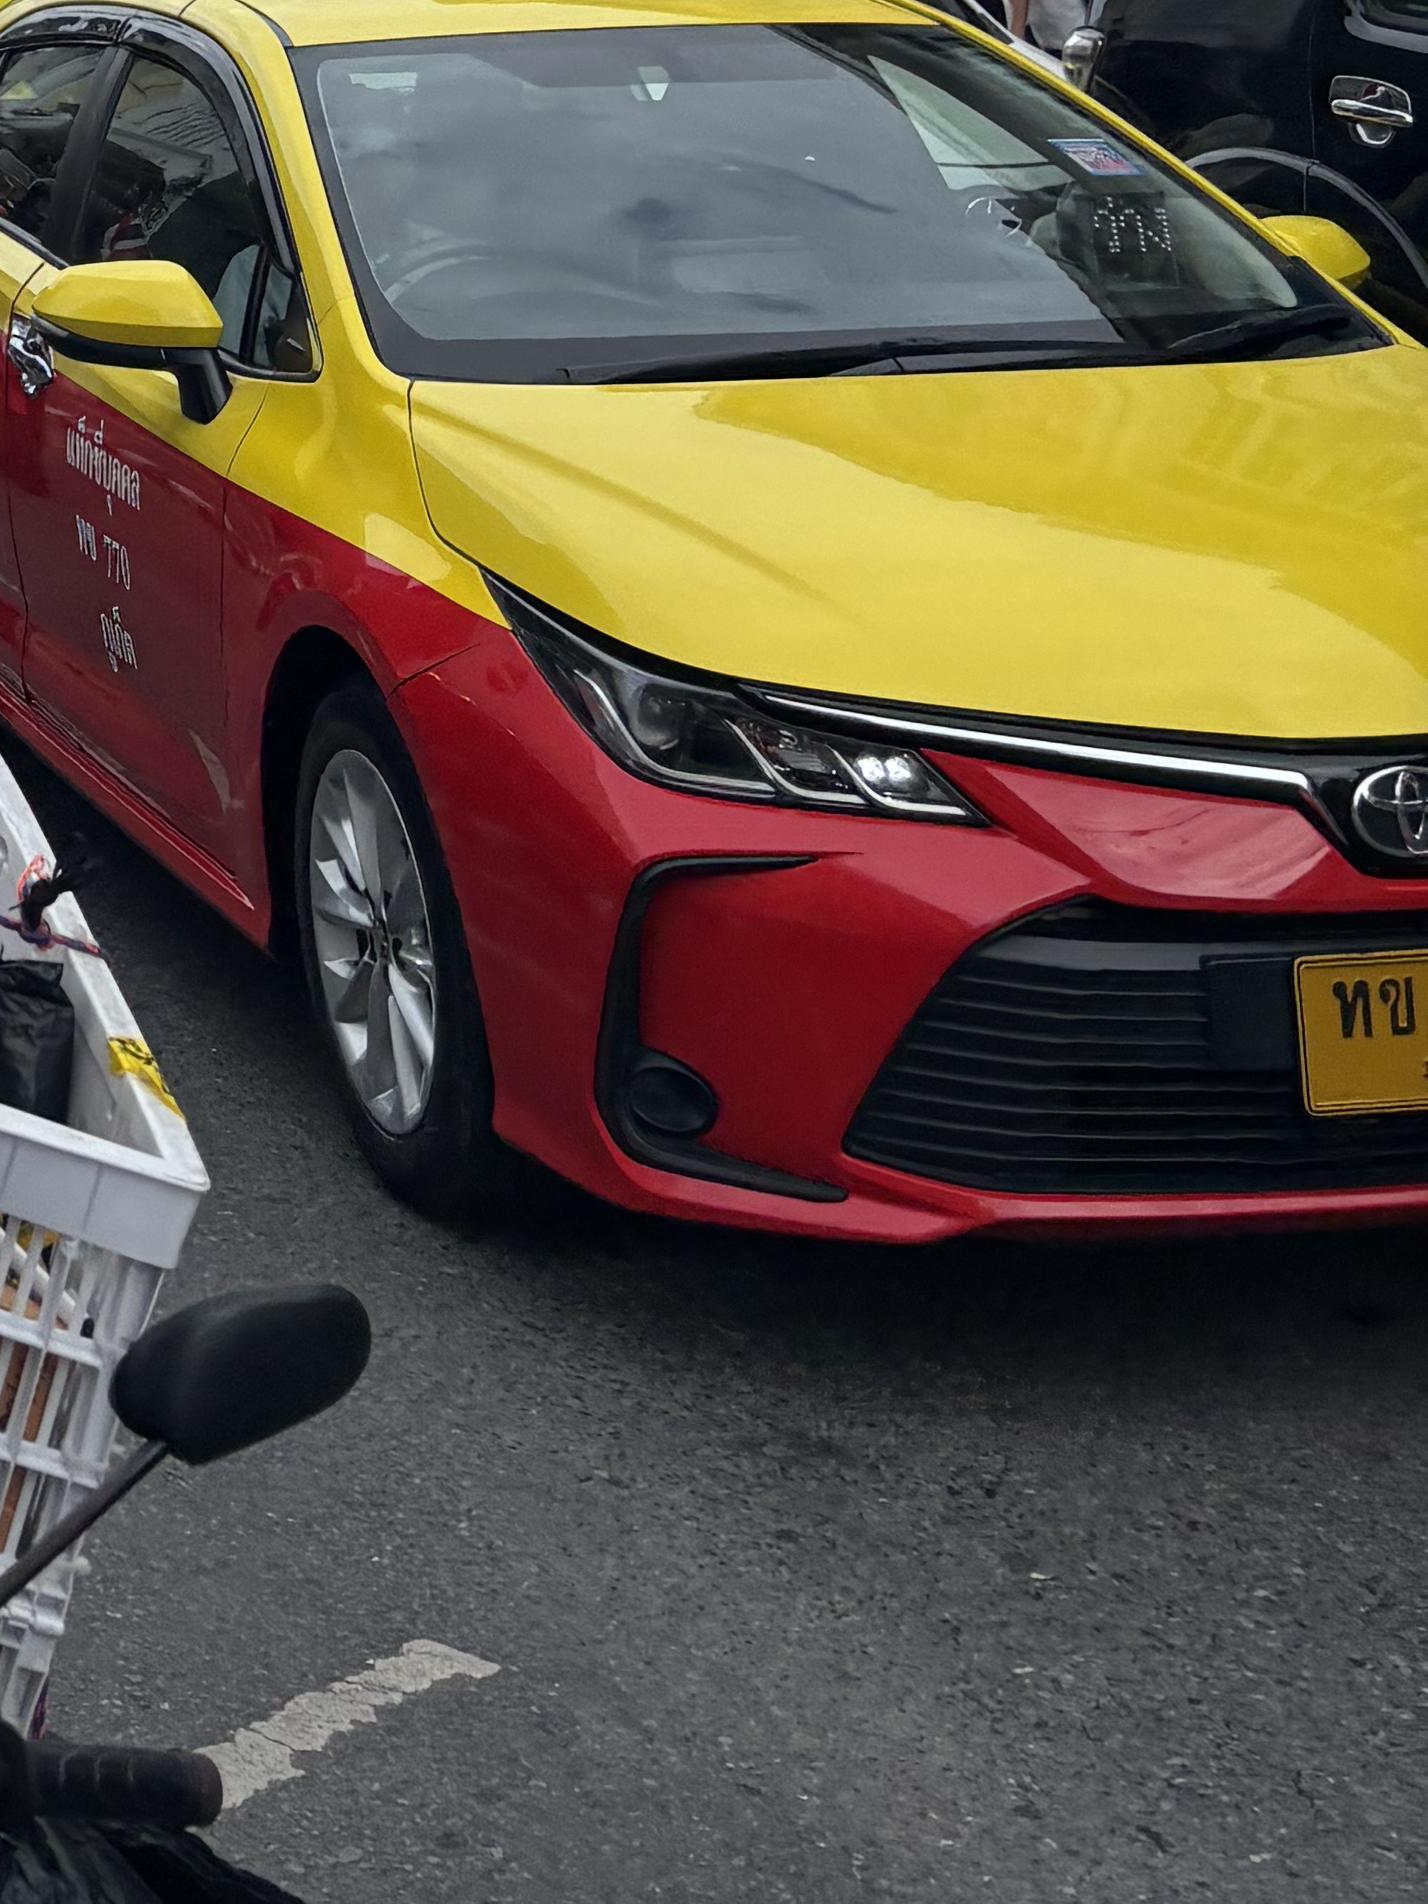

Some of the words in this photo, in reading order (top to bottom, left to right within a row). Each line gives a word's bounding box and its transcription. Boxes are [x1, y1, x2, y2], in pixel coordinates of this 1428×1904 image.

[1093, 196, 1172, 252] ว่าง
[104, 534, 131, 591] 770
[1333, 977, 1416, 1039] ทข
